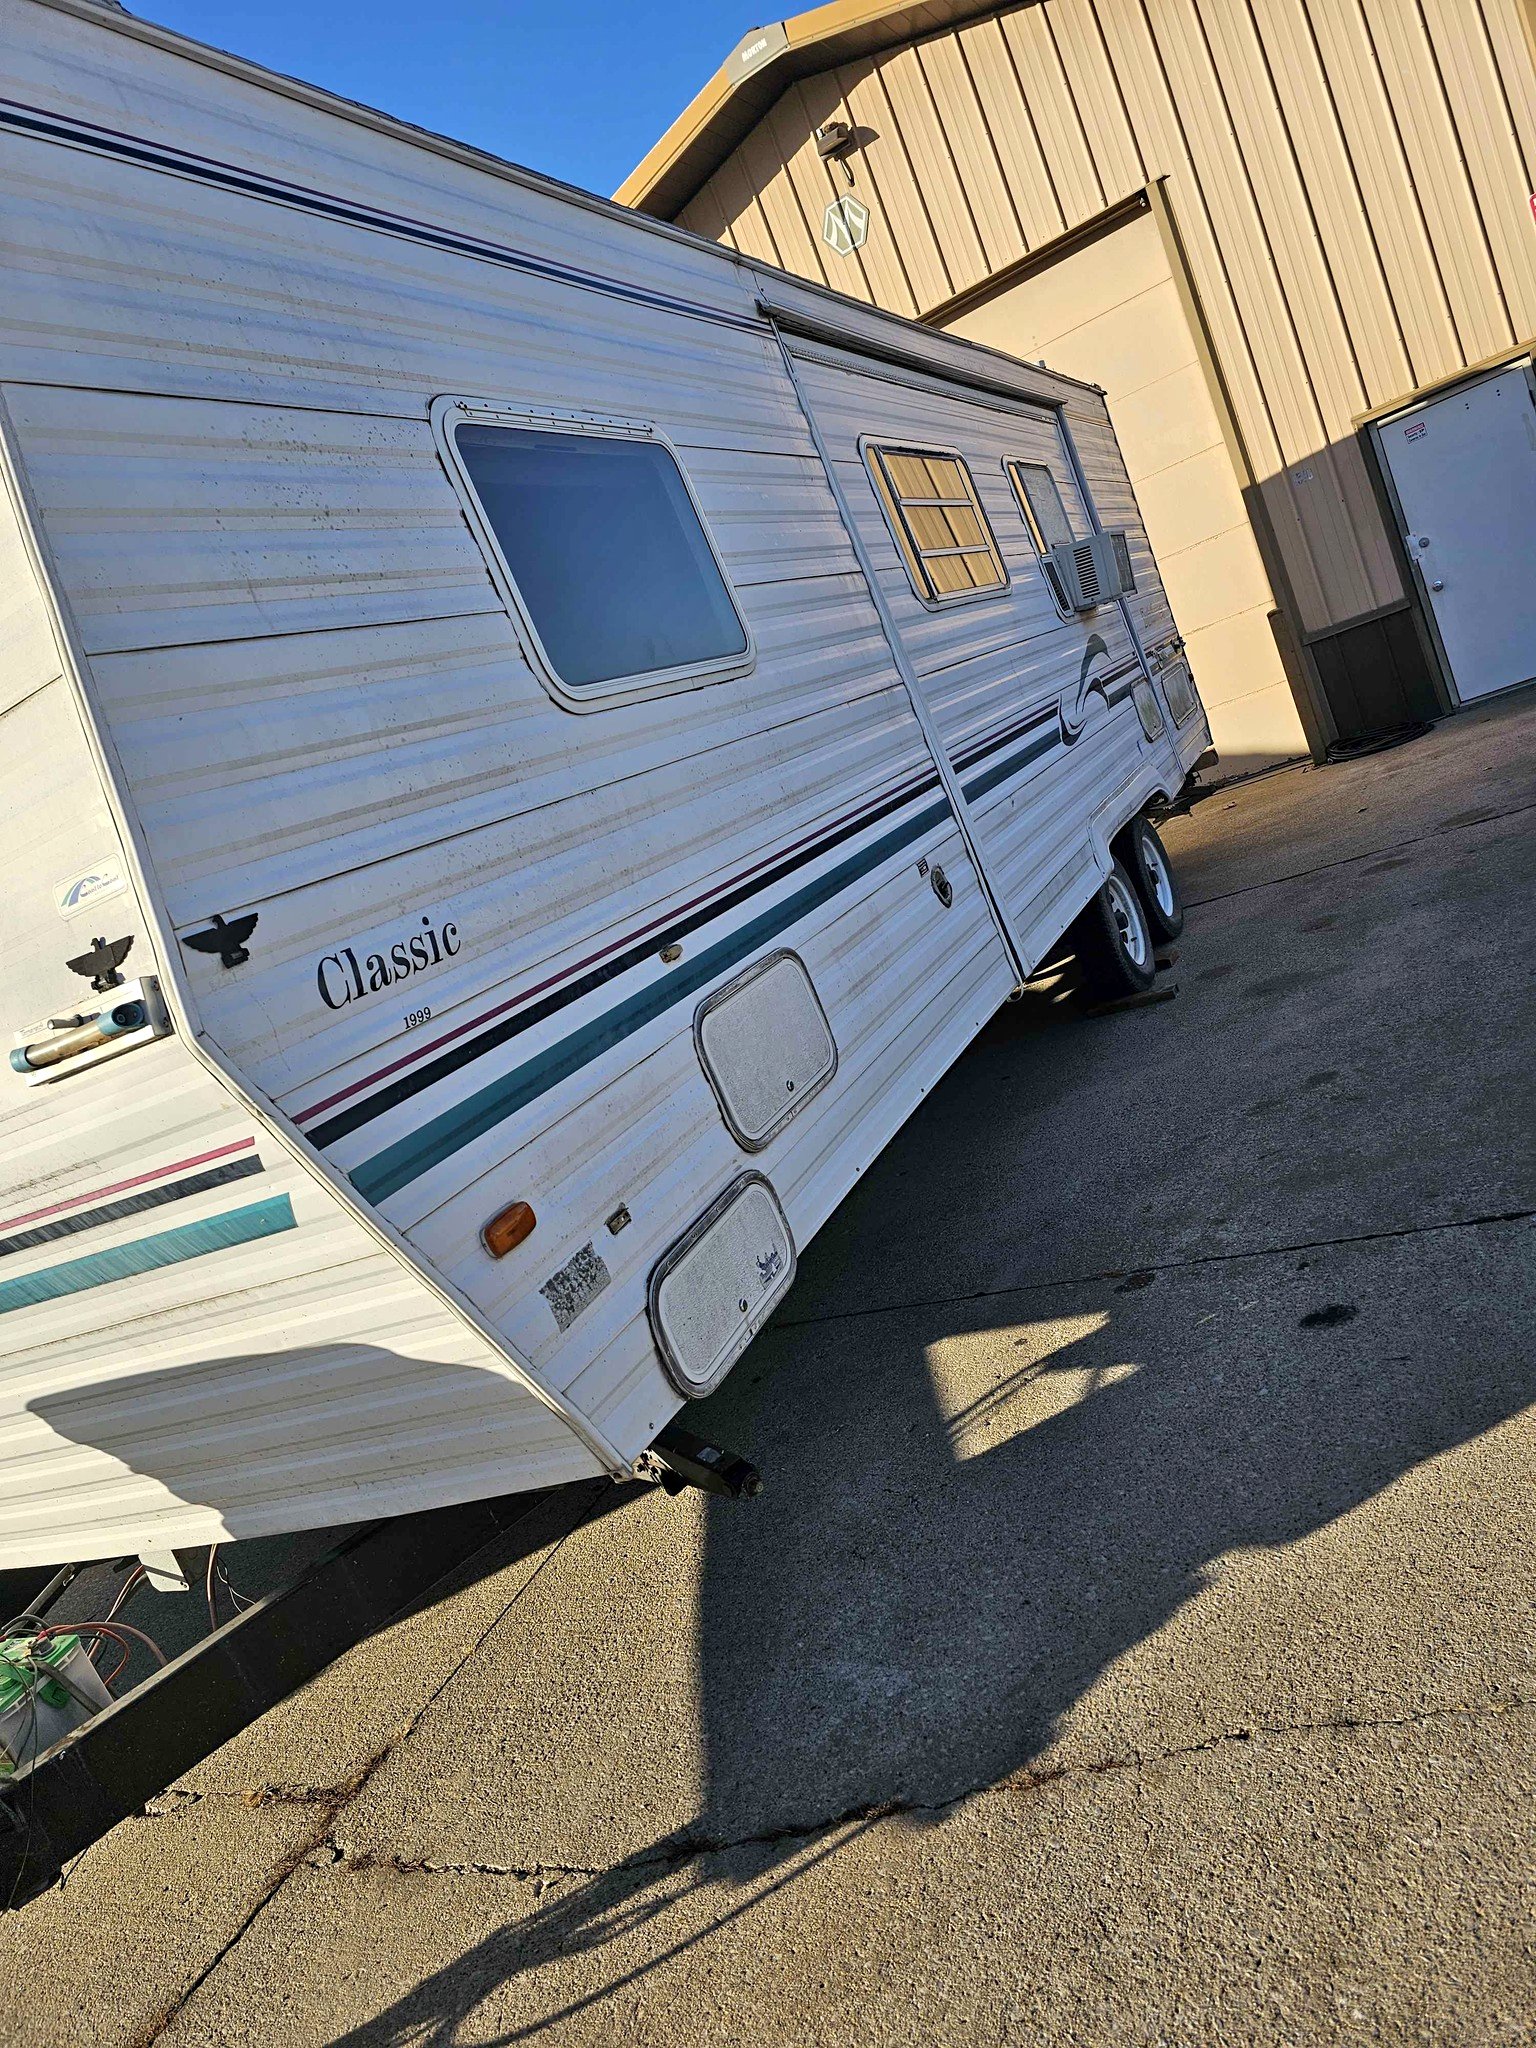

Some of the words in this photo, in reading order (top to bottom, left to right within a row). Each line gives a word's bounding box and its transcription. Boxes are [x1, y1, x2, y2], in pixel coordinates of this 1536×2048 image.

[742, 38, 767, 62] MORTON
[317, 916, 461, 1010] Classic
[403, 1006, 431, 1029] 1999
